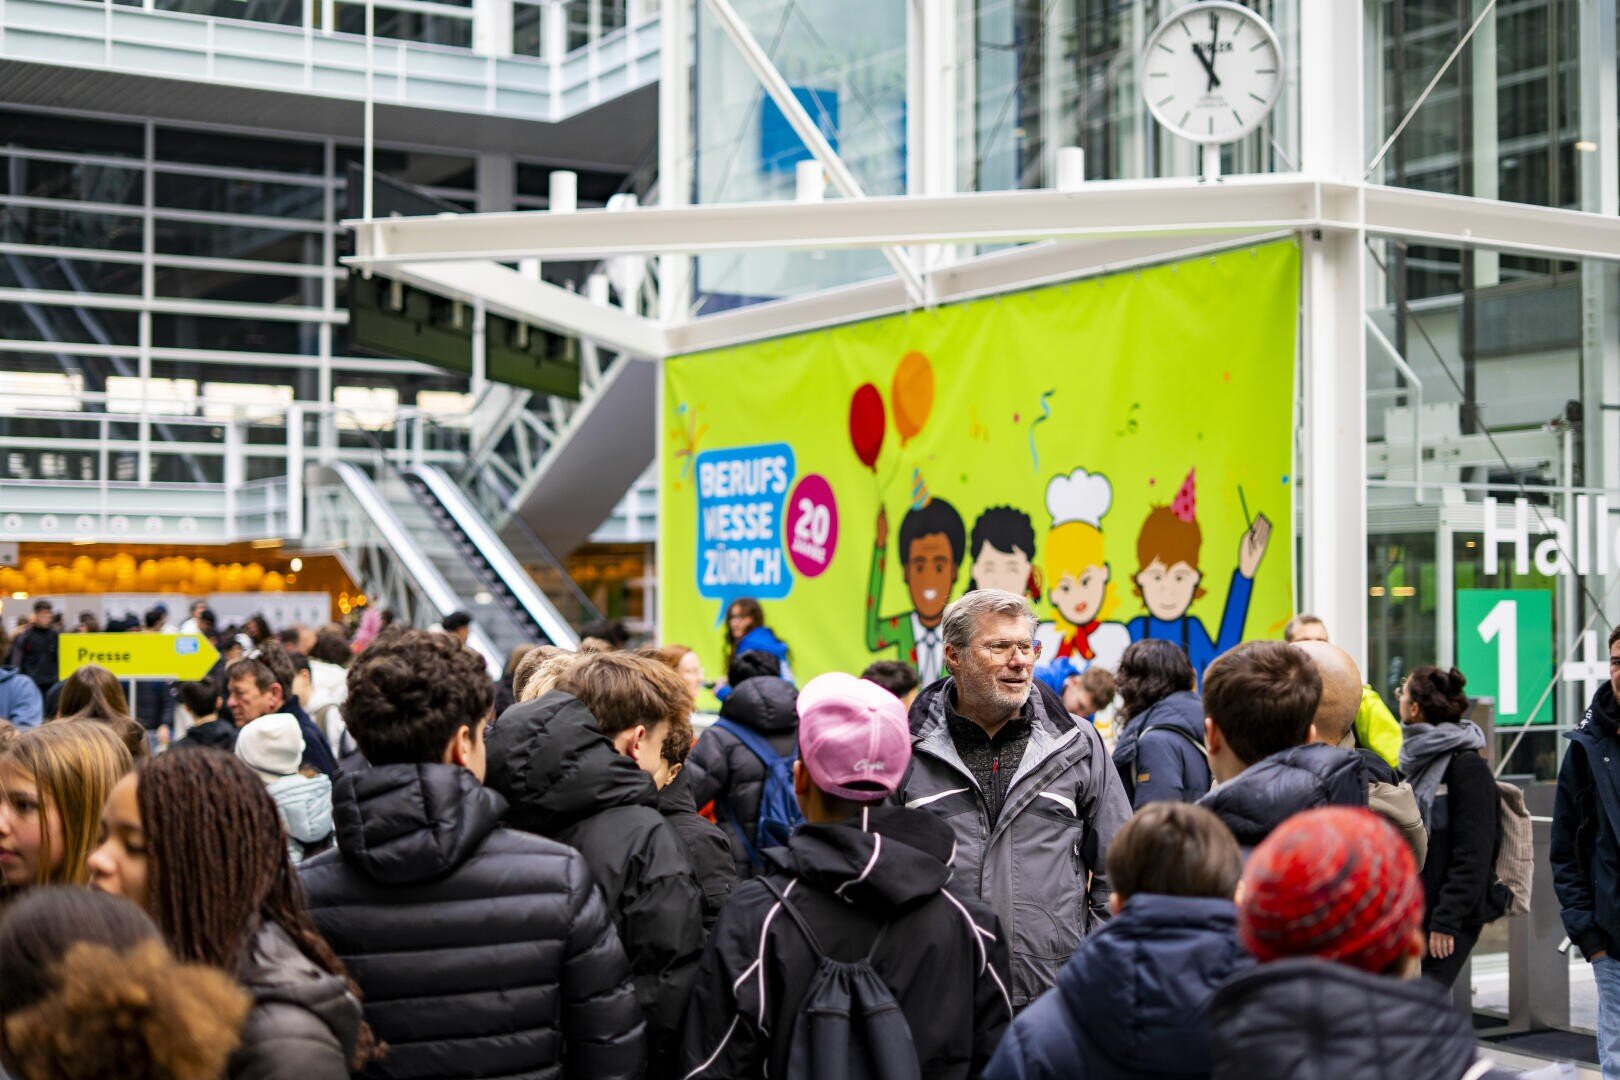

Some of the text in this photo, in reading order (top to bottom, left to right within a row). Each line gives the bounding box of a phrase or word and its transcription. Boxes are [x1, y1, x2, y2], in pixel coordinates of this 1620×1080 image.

[699, 455, 788, 498] BERUFS
[703, 501, 775, 541] MESSE
[794, 497, 831, 546] 20
[1483, 494, 1620, 577] Hall
[702, 542, 781, 585] ZÜRICH
[77, 647, 132, 663] Presse
[1477, 600, 1519, 715] 1
